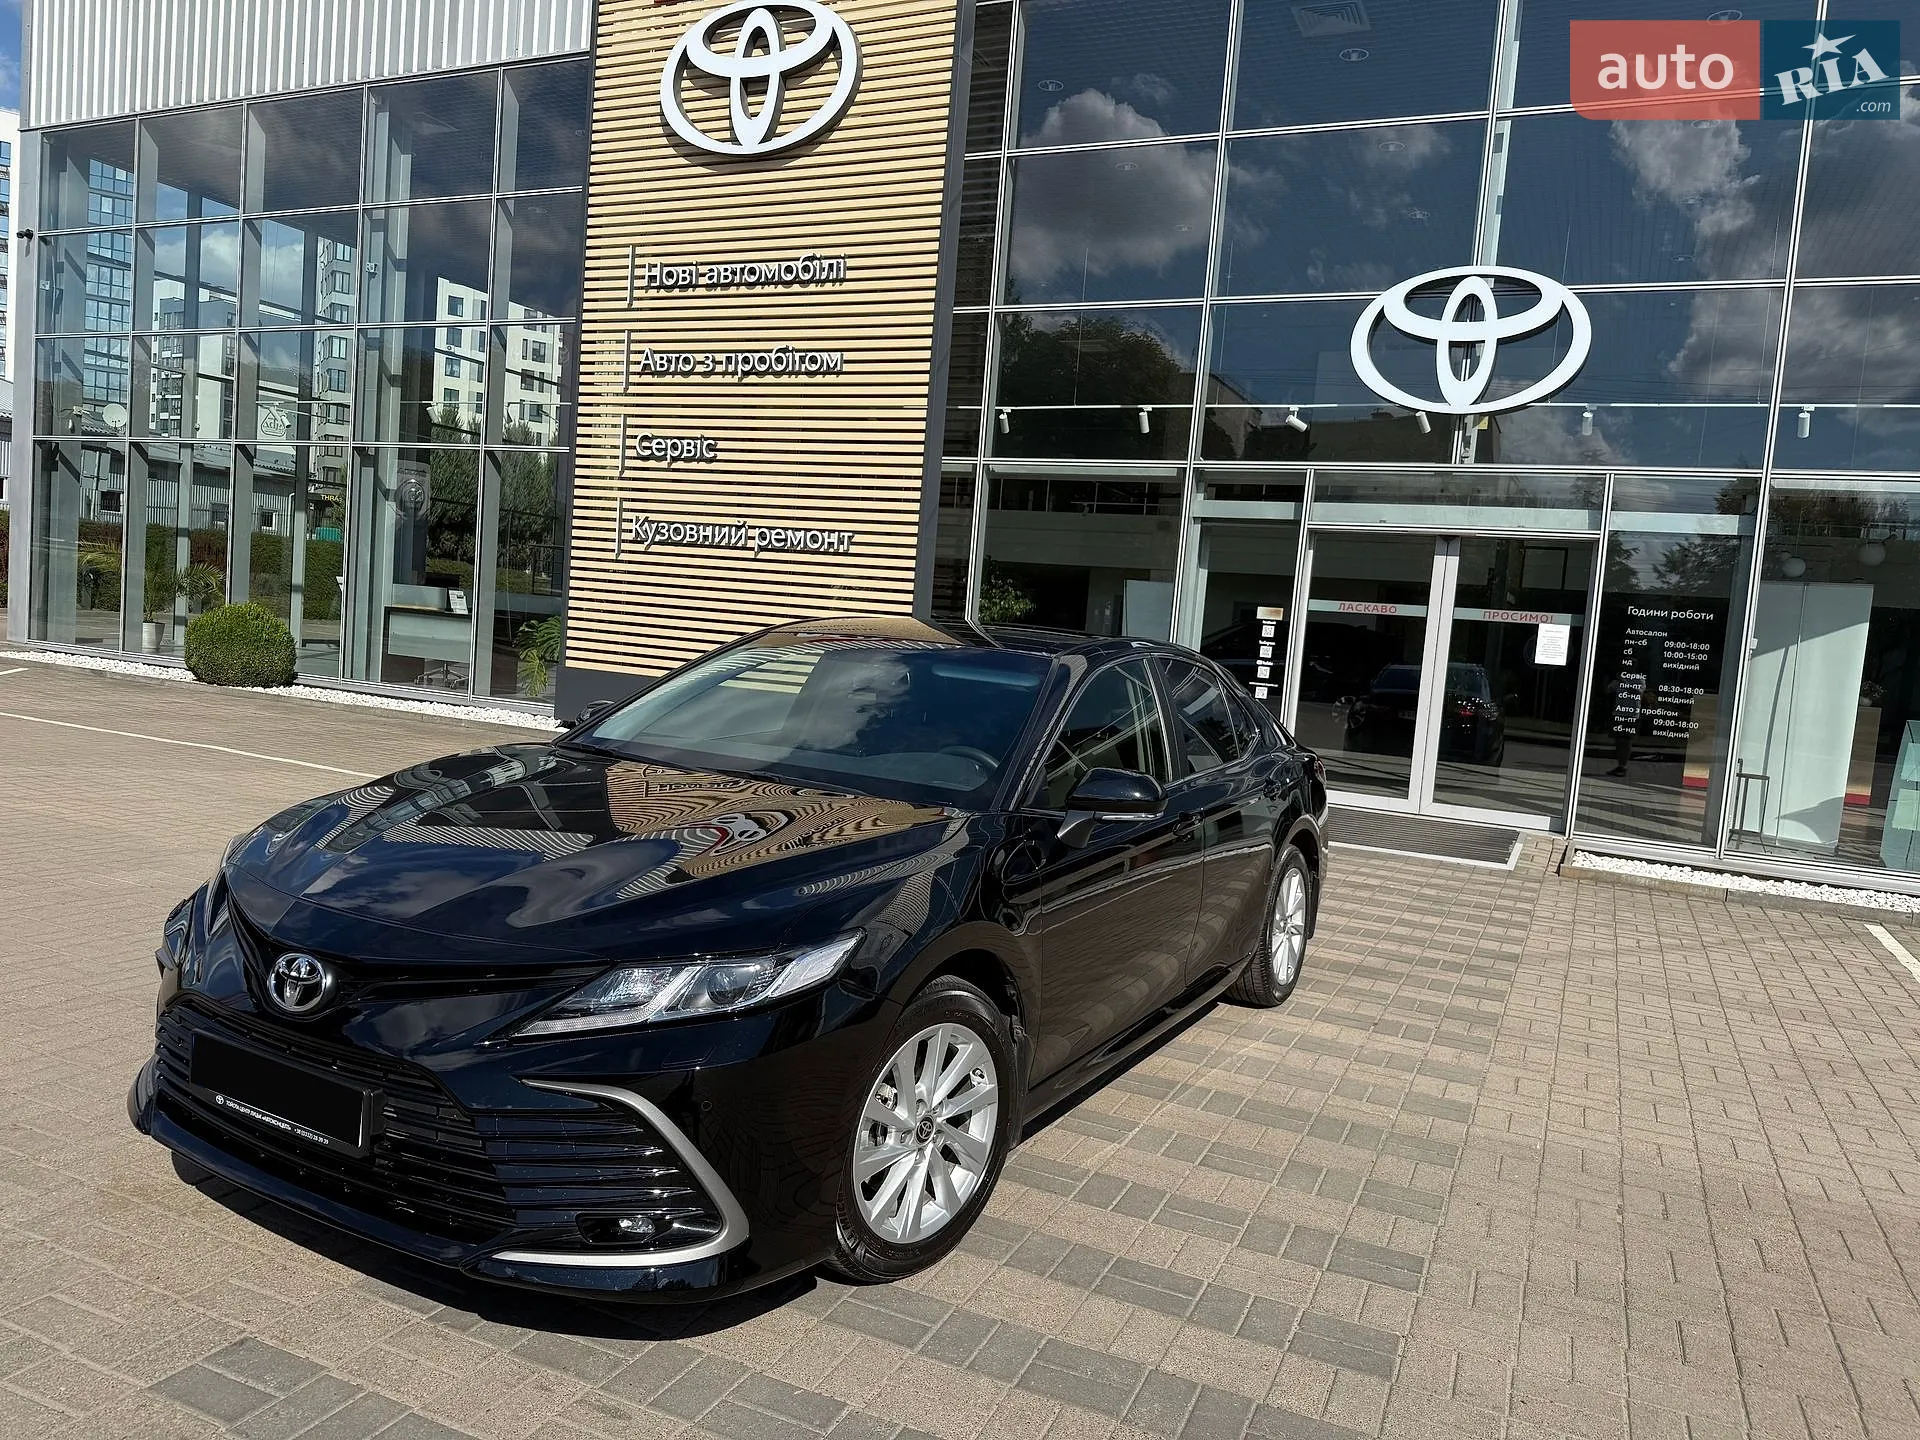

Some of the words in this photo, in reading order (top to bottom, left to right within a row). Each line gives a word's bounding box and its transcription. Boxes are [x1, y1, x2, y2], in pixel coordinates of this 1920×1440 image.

[644, 260, 698, 287] Нові
[705, 253, 847, 284] автомобілі
[640, 348, 696, 373] Авто
[702, 352, 715, 372] з
[722, 346, 844, 380] пробігом
[635, 433, 717, 464] Сервіс
[632, 514, 748, 550] Кузовний
[755, 526, 853, 557] ремонт
[1338, 602, 1398, 614] ЛАСКАВО
[1627, 606, 1669, 618] Години
[1671, 610, 1714, 621] роботи
[1483, 611, 1554, 624] ПРОСИМО!
[1626, 628, 1668, 637] Автосалон
[1624, 638, 1648, 646] пн-сб
[1664, 641, 1710, 651] 09:00-18:00
[1663, 651, 1708, 661] 10:00-15:00
[1662, 662, 1699, 671] вихідний
[1621, 672, 1647, 680] Сервіс
[1658, 685, 1704, 695] 08:30-18:00
[1618, 692, 1641, 701] сб-нд
[1657, 696, 1695, 705] вихідний
[1616, 705, 1634, 713] Авто
[1641, 708, 1678, 717] пробігом
[1614, 715, 1637, 723] пн-пт
[1653, 718, 1699, 729] 09:00-18:00
[1613, 725, 1636, 734] сб-нд
[1652, 729, 1690, 739] вихідний
